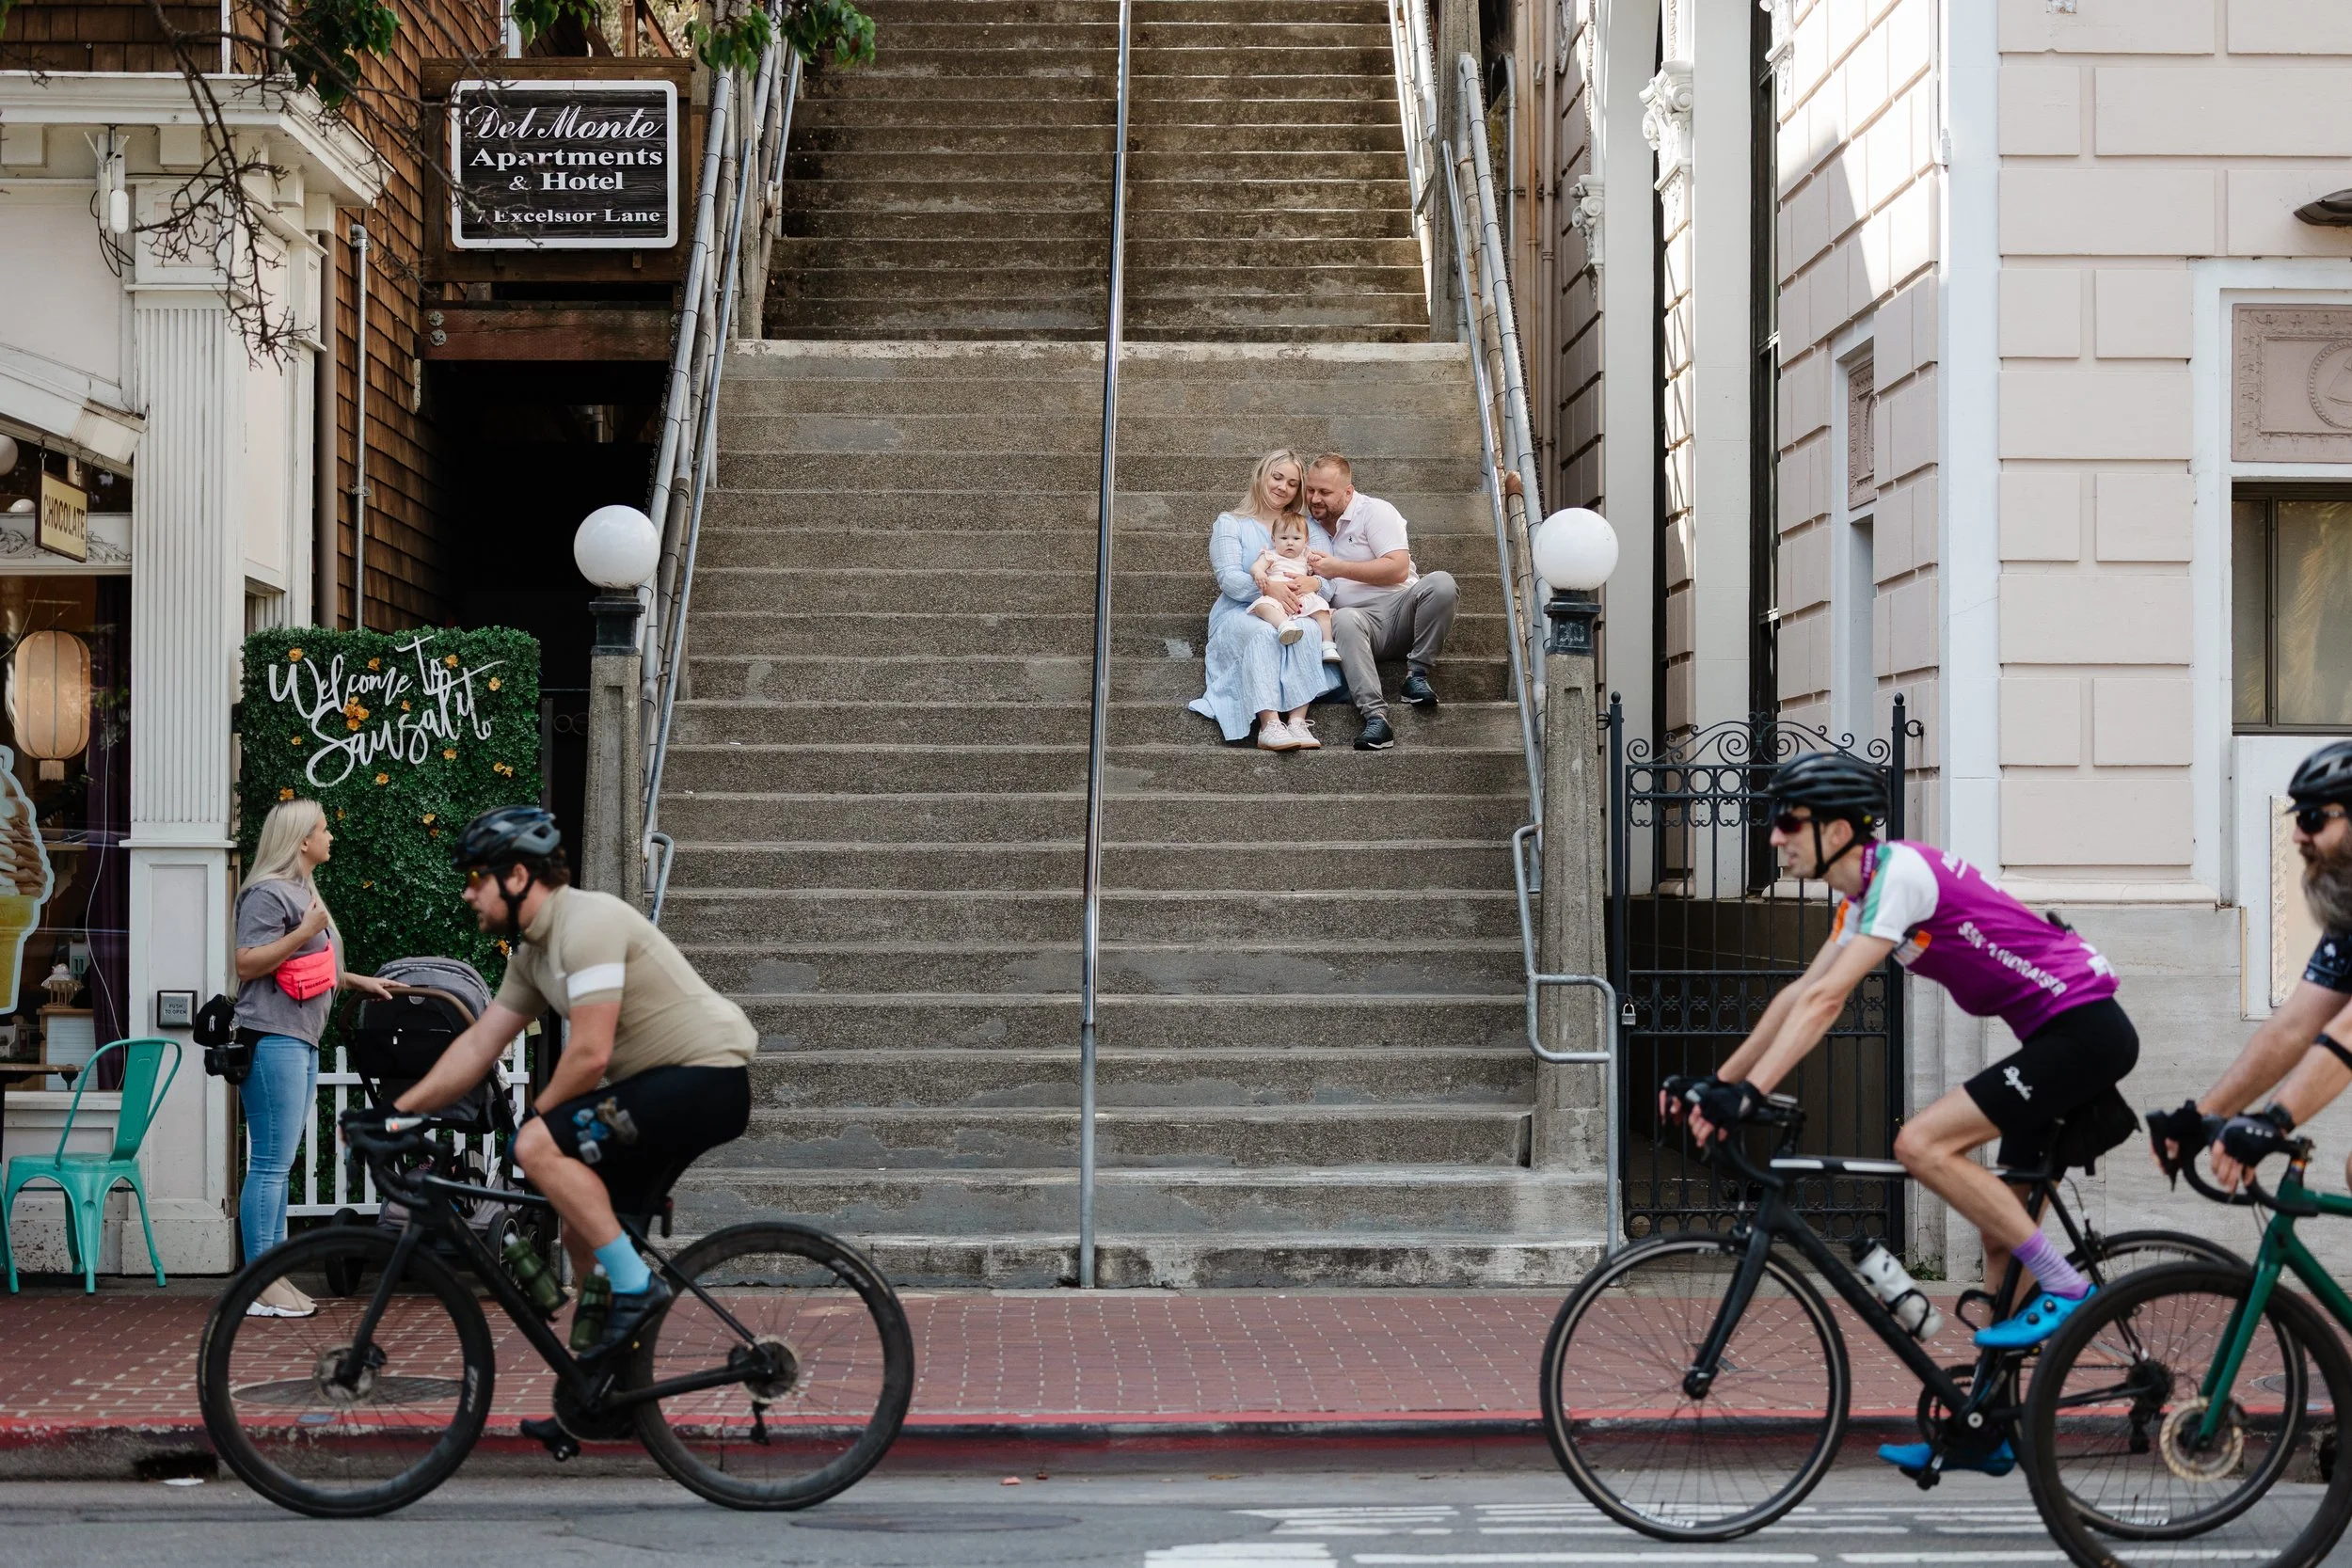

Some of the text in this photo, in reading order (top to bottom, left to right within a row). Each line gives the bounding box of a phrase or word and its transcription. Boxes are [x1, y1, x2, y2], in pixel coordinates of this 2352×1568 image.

[465, 105, 663, 139] Del Monte
[469, 147, 663, 171] Apartments
[509, 171, 624, 191] & Hotel
[493, 209, 596, 224] Excelsior
[604, 208, 660, 223] Lane
[43, 494, 85, 540] CHOCOLATE
[268, 654, 413, 720] Welcome
[306, 659, 506, 787] Sausalito
